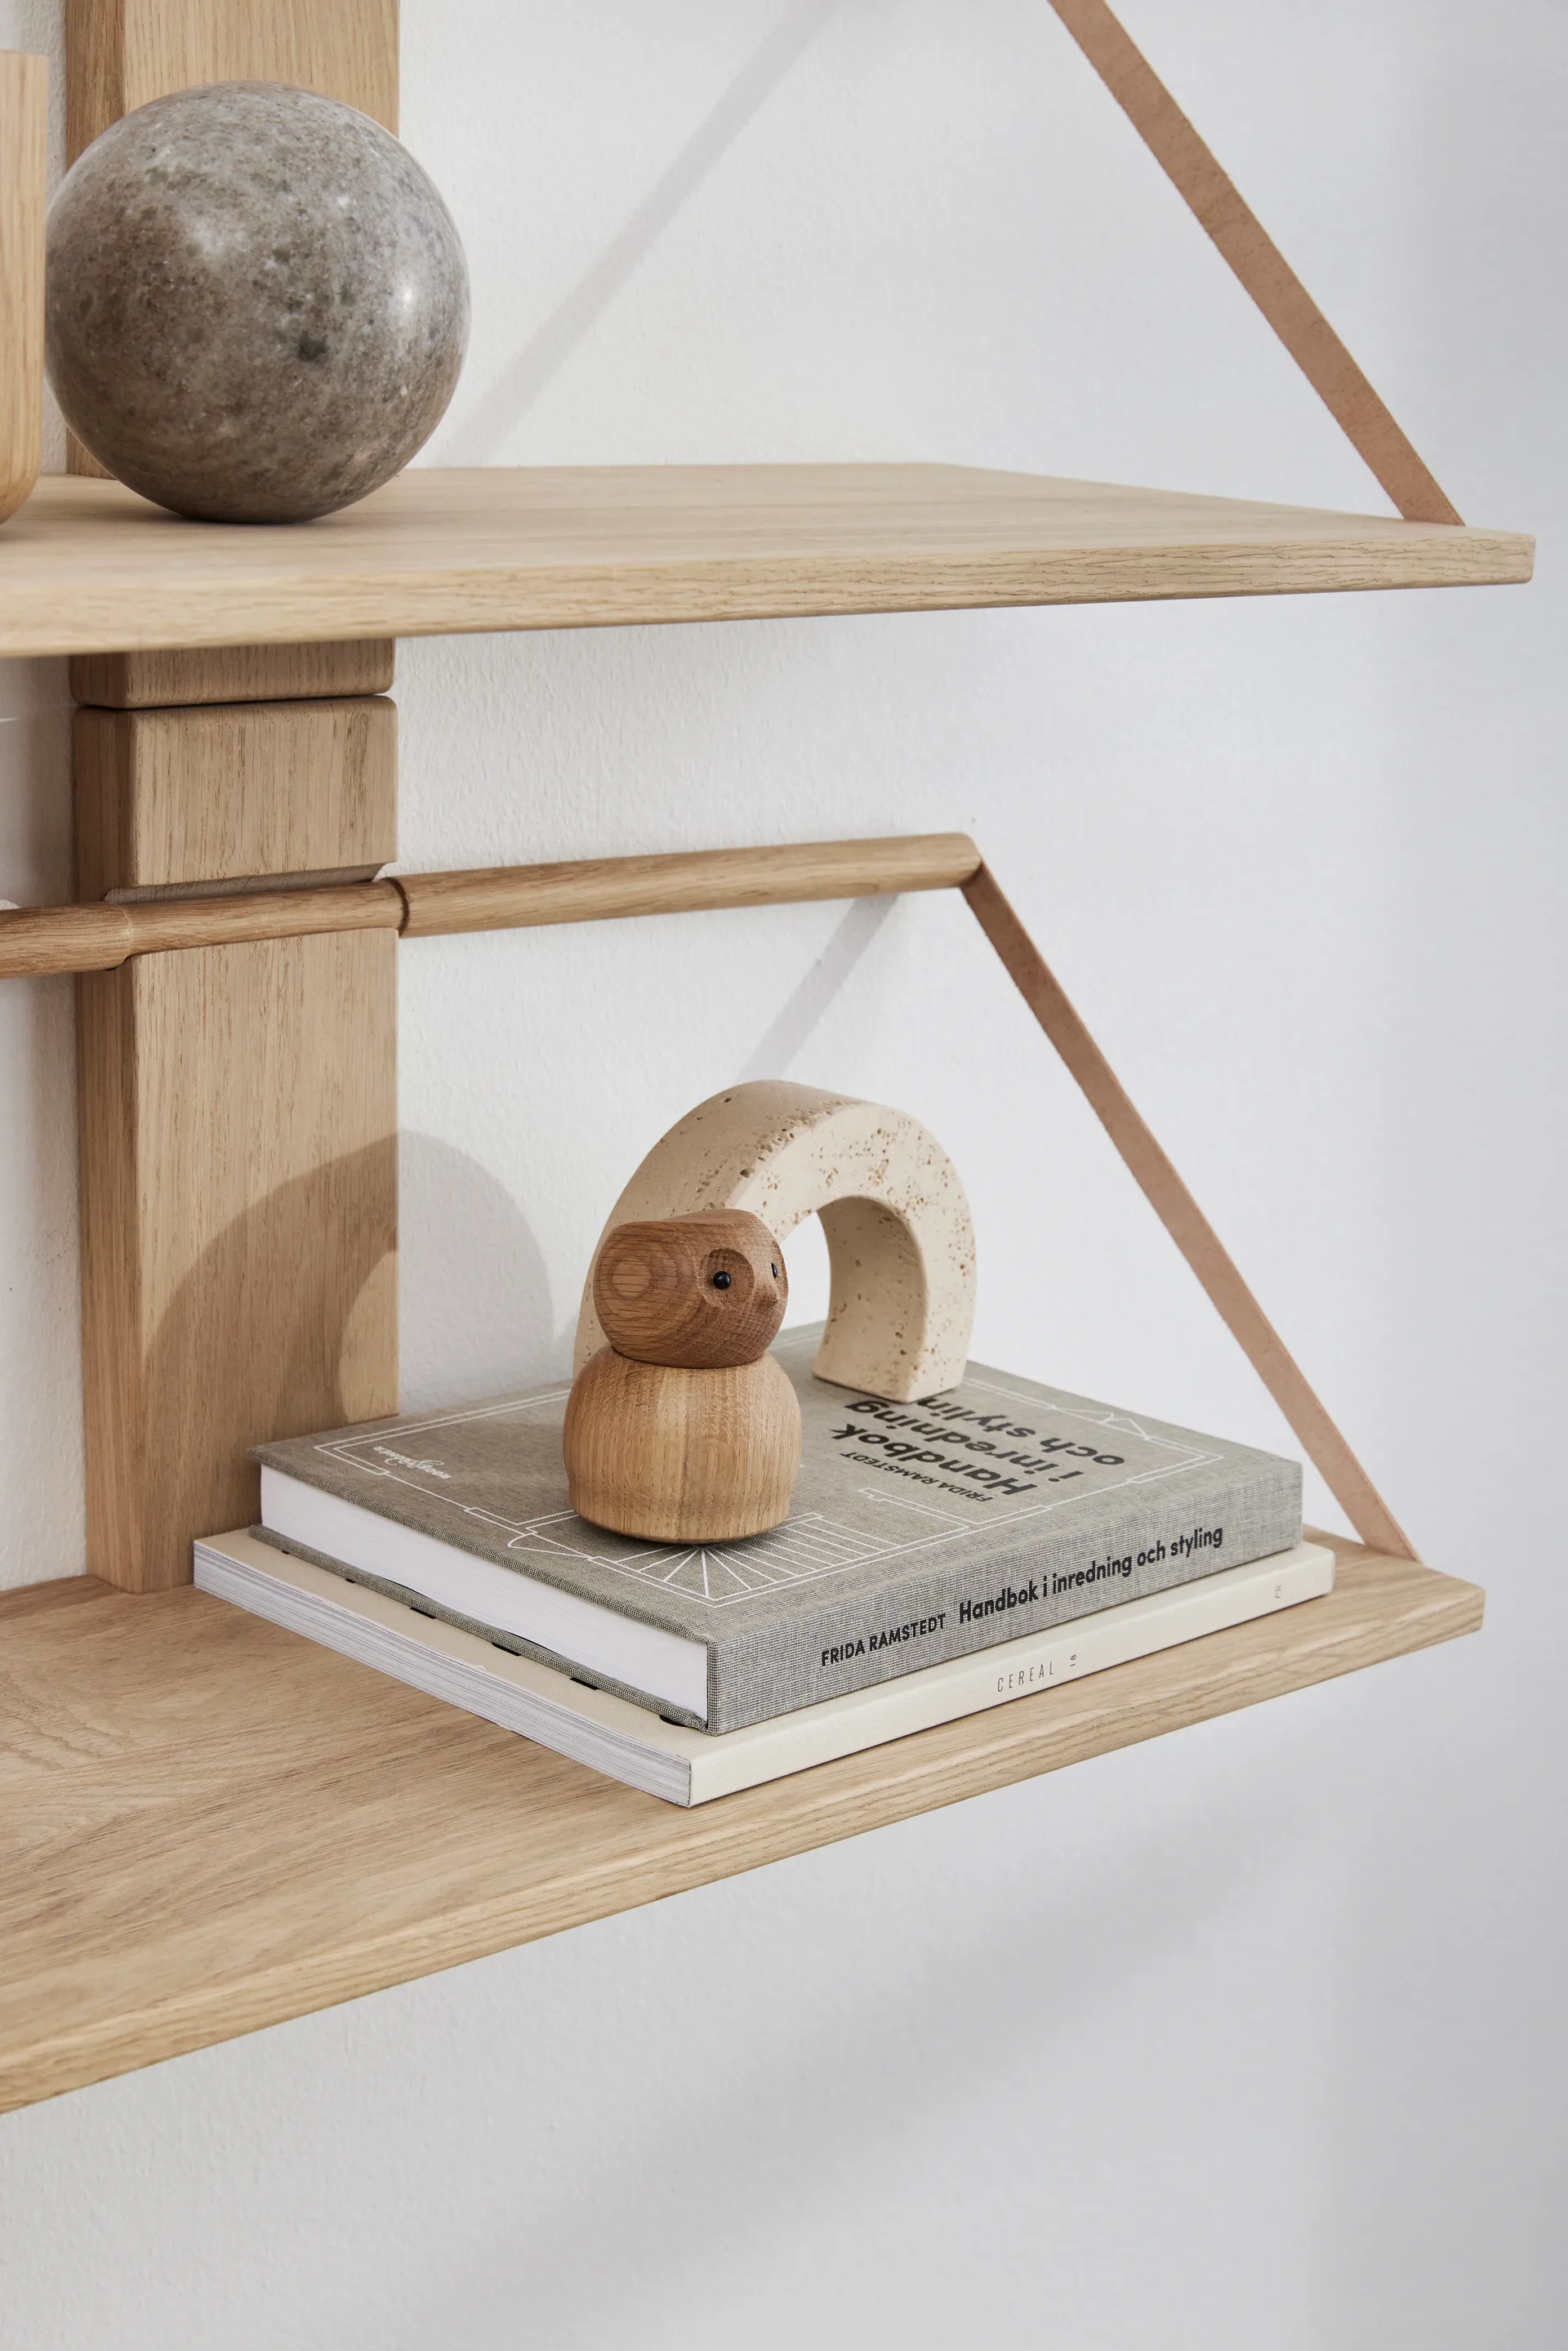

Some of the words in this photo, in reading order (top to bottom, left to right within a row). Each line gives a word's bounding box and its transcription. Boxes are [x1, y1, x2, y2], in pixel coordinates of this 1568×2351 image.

[917, 1398, 1036, 1439] stylin
[844, 1400, 1059, 1475] inredning
[1040, 1437, 1125, 1465] och
[830, 1424, 1038, 1495] Handbok
[840, 1452, 939, 1484] RAMSTEDT
[938, 1482, 994, 1502] FRIDA
[1048, 1470, 1085, 1483] i
[821, 1639, 866, 1666] FRIDA
[869, 1613, 947, 1653] RAMSTEDT
[959, 1580, 1039, 1624] Handbok
[1042, 1575, 1048, 1598] i
[1052, 1555, 1133, 1594] inredning
[1136, 1540, 1166, 1567] och
[1169, 1527, 1223, 1558] styling
[997, 1661, 1054, 1693] CEREAL
